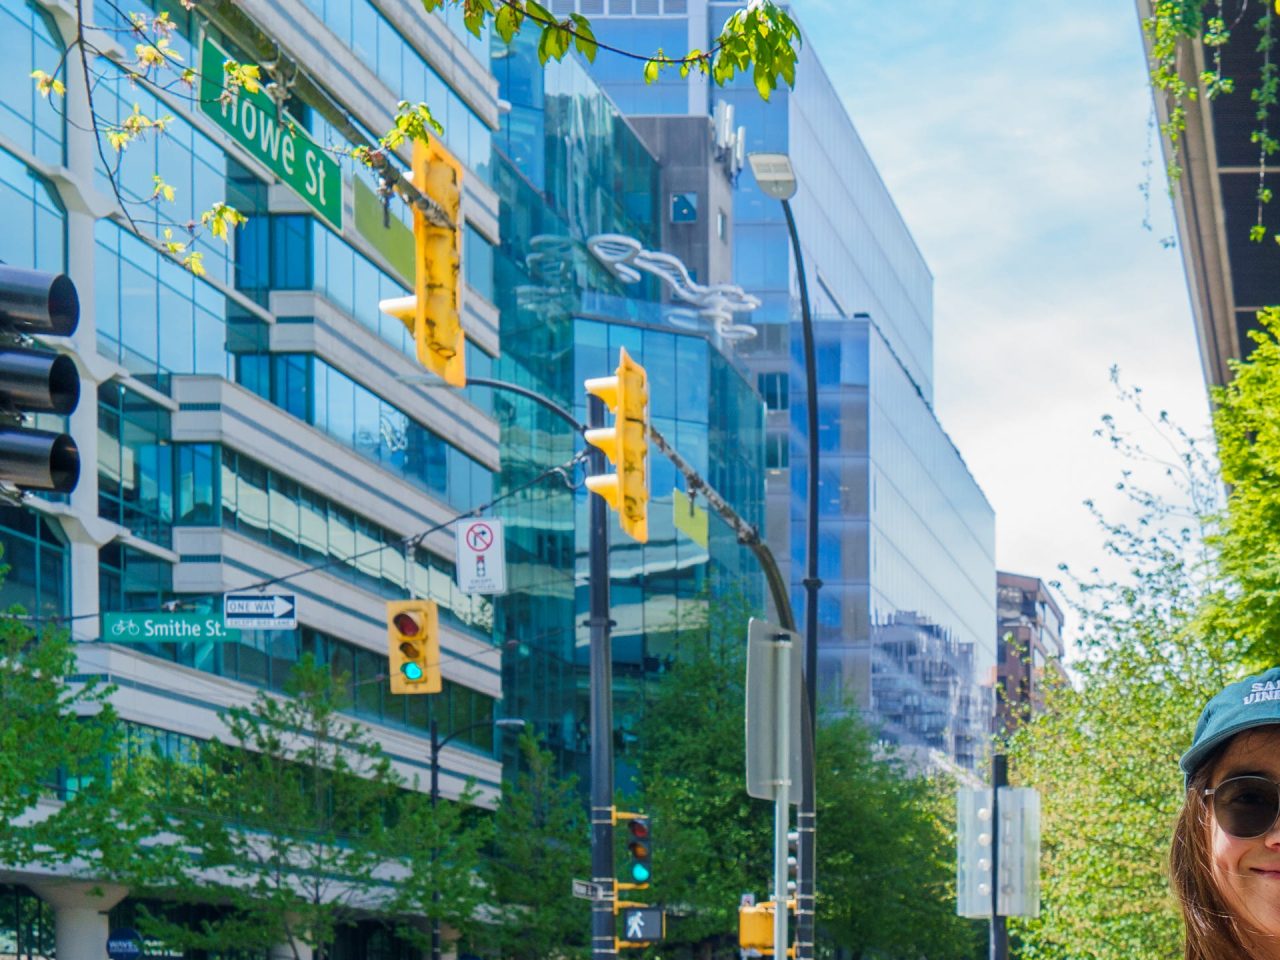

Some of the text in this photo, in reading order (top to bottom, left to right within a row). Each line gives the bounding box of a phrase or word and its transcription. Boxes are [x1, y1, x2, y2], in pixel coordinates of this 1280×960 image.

[221, 64, 327, 206] Howe St
[229, 602, 275, 612] ONE WAY
[144, 619, 228, 637] Smithe St.
